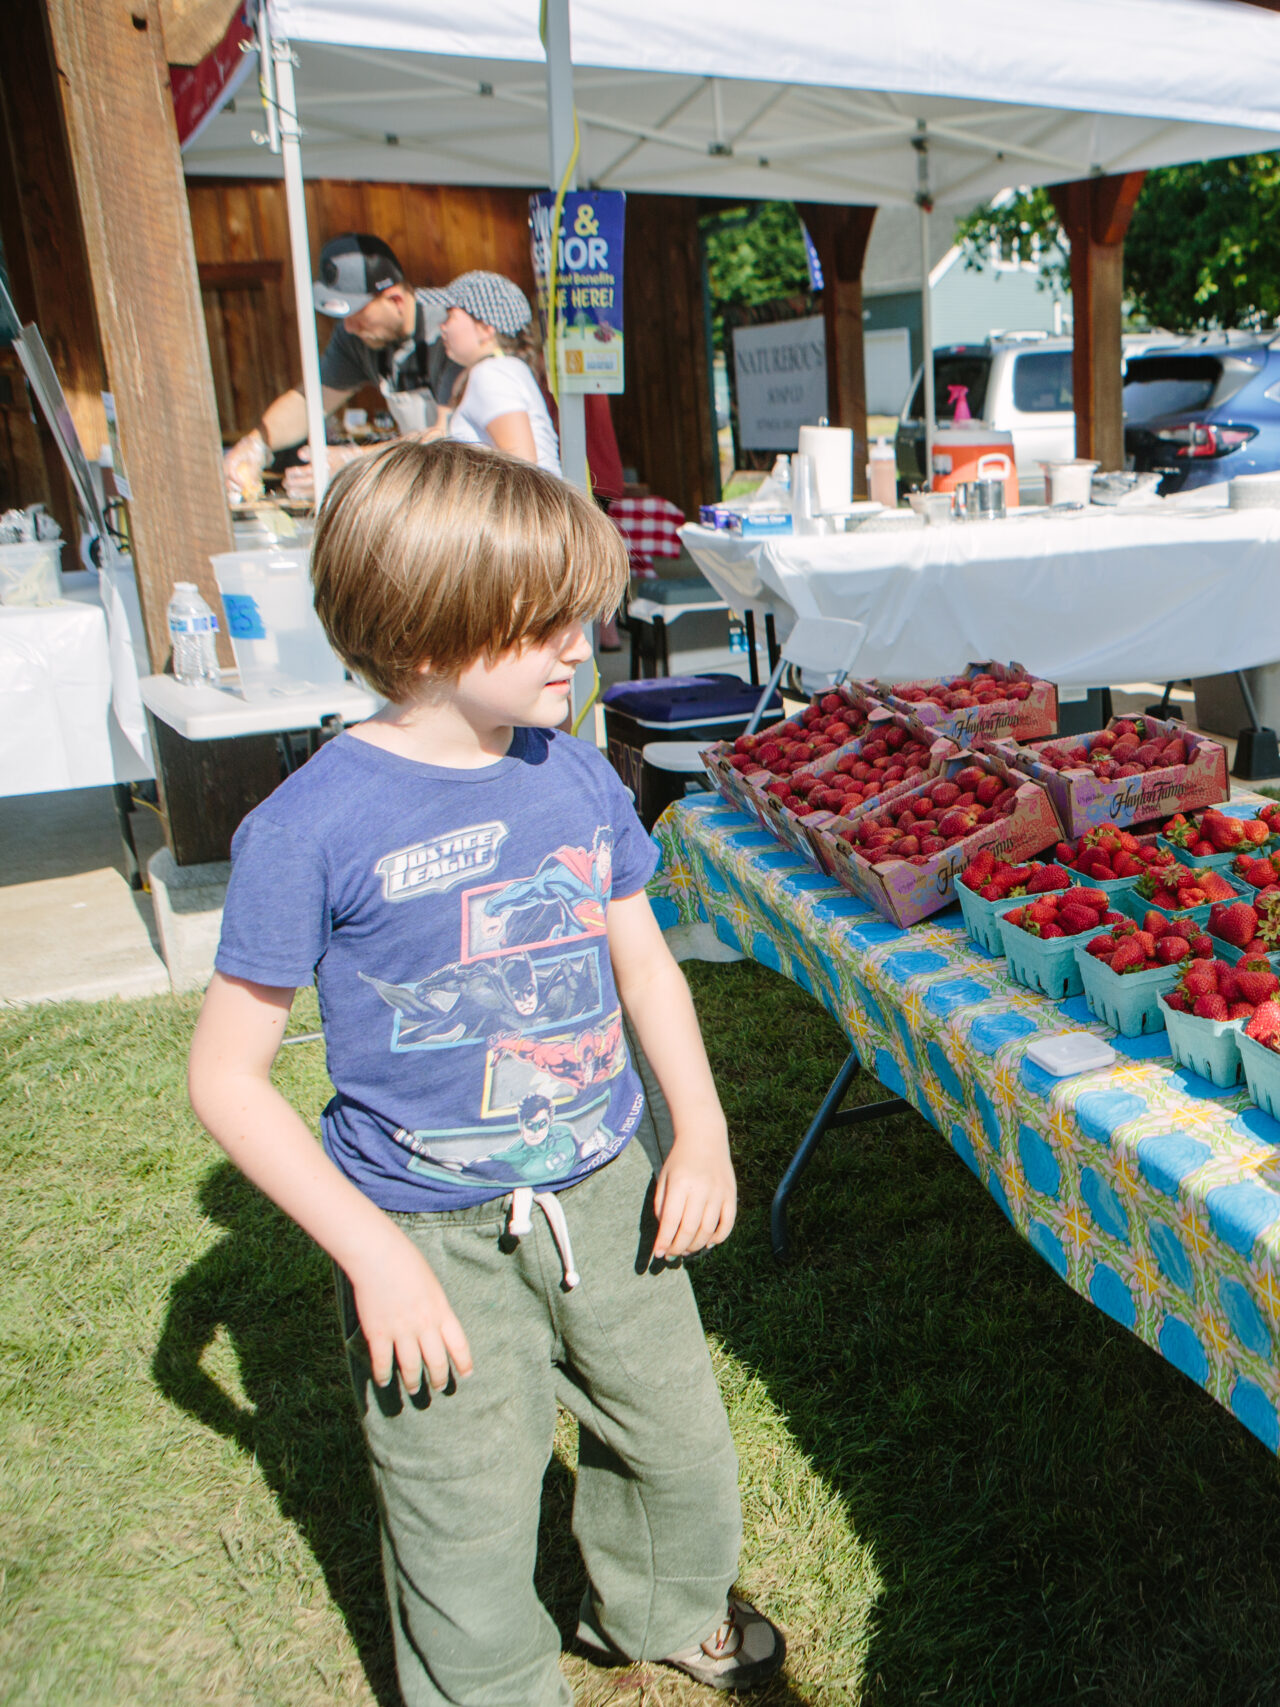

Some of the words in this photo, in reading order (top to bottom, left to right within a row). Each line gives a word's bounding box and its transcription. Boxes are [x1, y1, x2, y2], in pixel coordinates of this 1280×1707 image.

[571, 288, 614, 309] HERE!
[1109, 784, 1158, 819] Hayton
[391, 849, 491, 893] LEAGUE
[393, 833, 493, 873] JUSTICE
